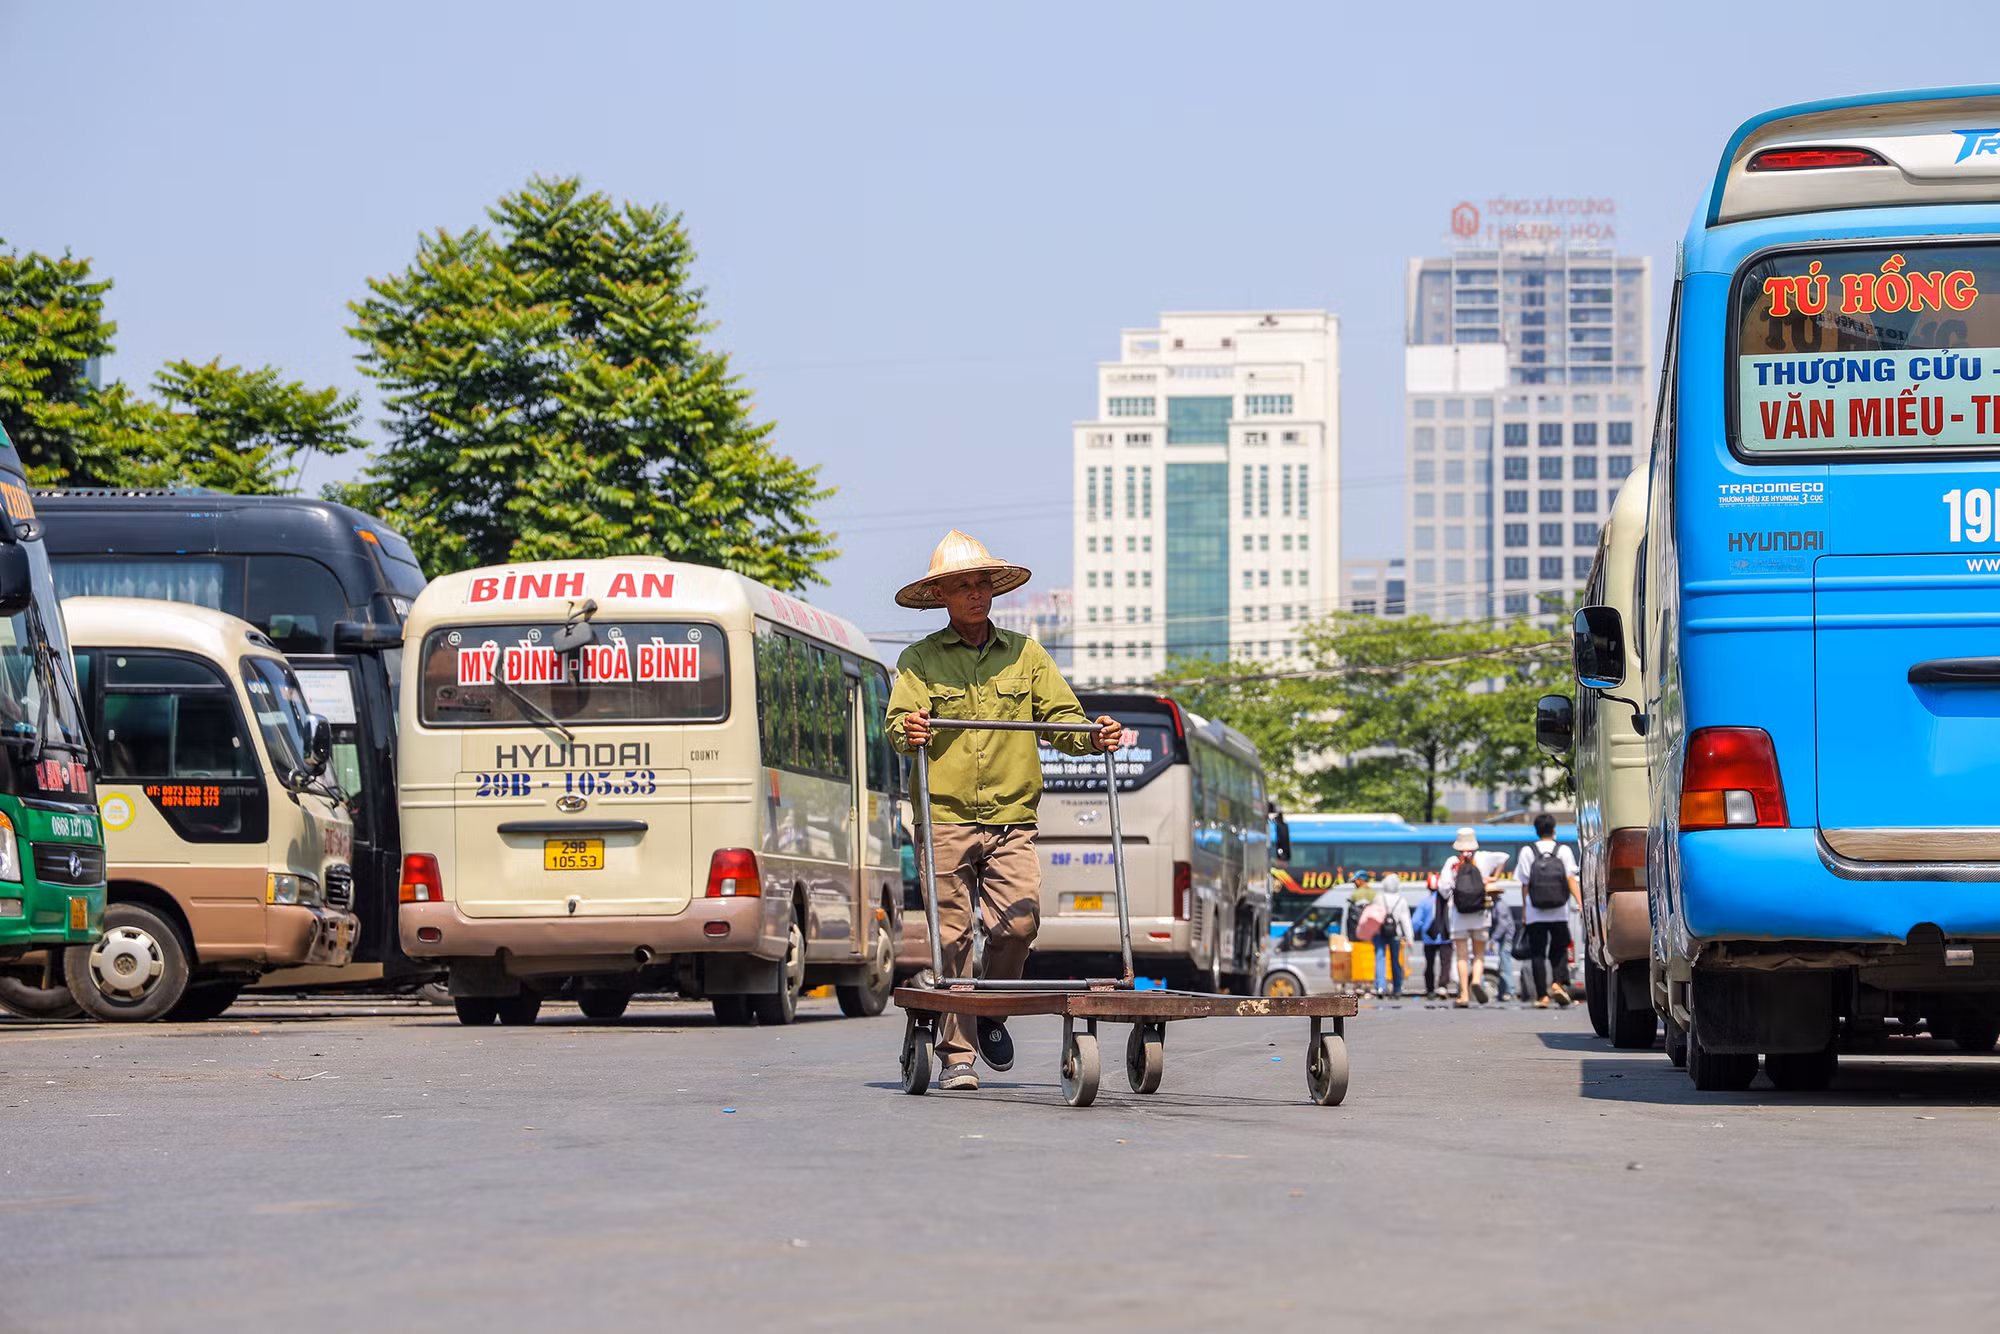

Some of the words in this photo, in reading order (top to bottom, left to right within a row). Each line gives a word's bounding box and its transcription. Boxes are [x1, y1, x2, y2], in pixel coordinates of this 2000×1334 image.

[1763, 260, 1830, 317] TÚ
[1840, 254, 1979, 313] HỒNG
[1753, 357, 1896, 389] THƯỢNG
[1909, 349, 1982, 381] CỬU
[1759, 392, 1835, 440] VĂN
[1849, 384, 1944, 437] MIẾU
[1971, 395, 2000, 435] T
[1718, 482, 1824, 494] TRACOMECO
[1800, 493, 1808, 505] 3
[1942, 487, 2000, 542] 19
[1728, 531, 1824, 552] HYUNDAI
[470, 571, 585, 603] BÌNH
[607, 573, 675, 598] AN
[460, 642, 496, 684] MỸ
[507, 641, 564, 681] ĐÌNH
[583, 640, 629, 680] HOÀ
[640, 640, 697, 679] BÌNH
[496, 743, 650, 768] HYUNDAI
[690, 750, 720, 761] COUNTY
[161, 785, 184, 796] 0973
[185, 785, 201, 796] 535
[475, 773, 531, 797] 29B
[565, 770, 657, 796] 105.53
[161, 796, 184, 807] 0974
[202, 796, 219, 807] 373
[561, 842, 587, 854] 29B
[552, 856, 597, 868] 105.53
